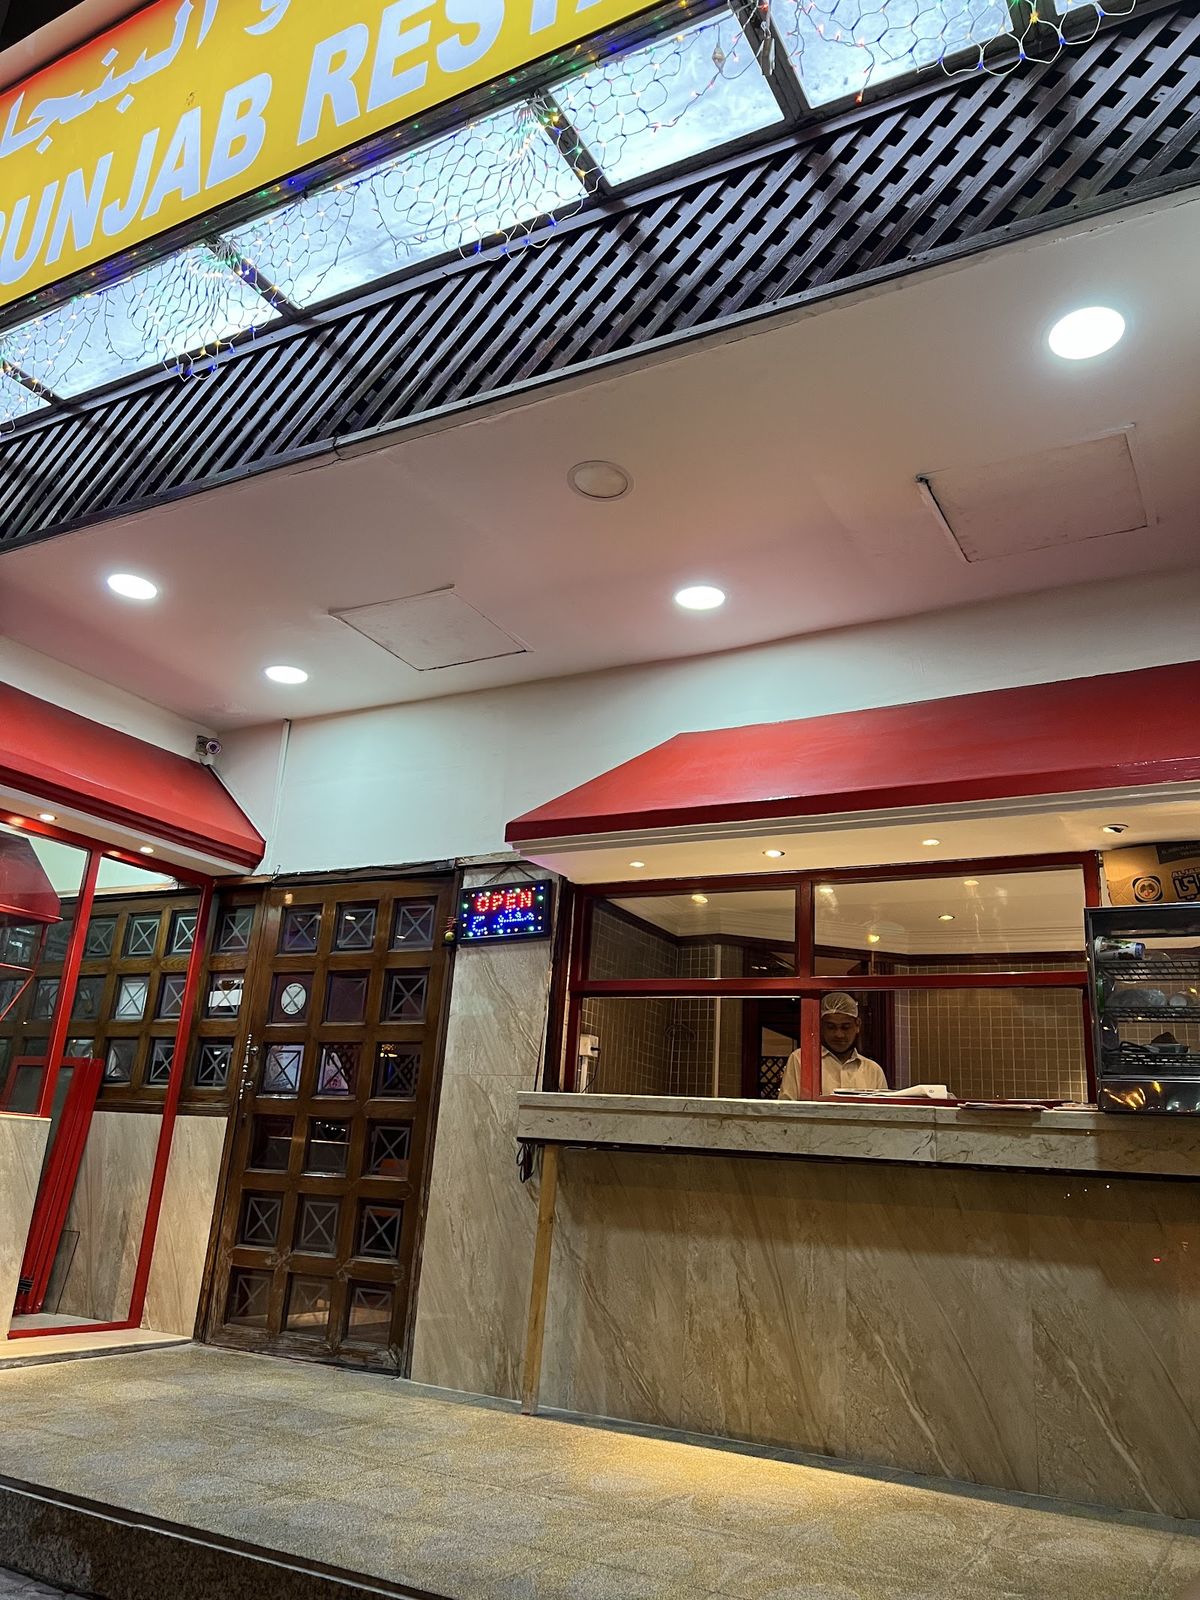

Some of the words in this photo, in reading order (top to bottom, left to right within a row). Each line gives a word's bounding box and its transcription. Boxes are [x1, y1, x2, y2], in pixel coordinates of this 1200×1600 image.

[0, 72, 273, 285] UNJAB
[297, 0, 600, 146] RES
[476, 890, 532, 912] OPEN
[471, 907, 535, 933] مفتوح
